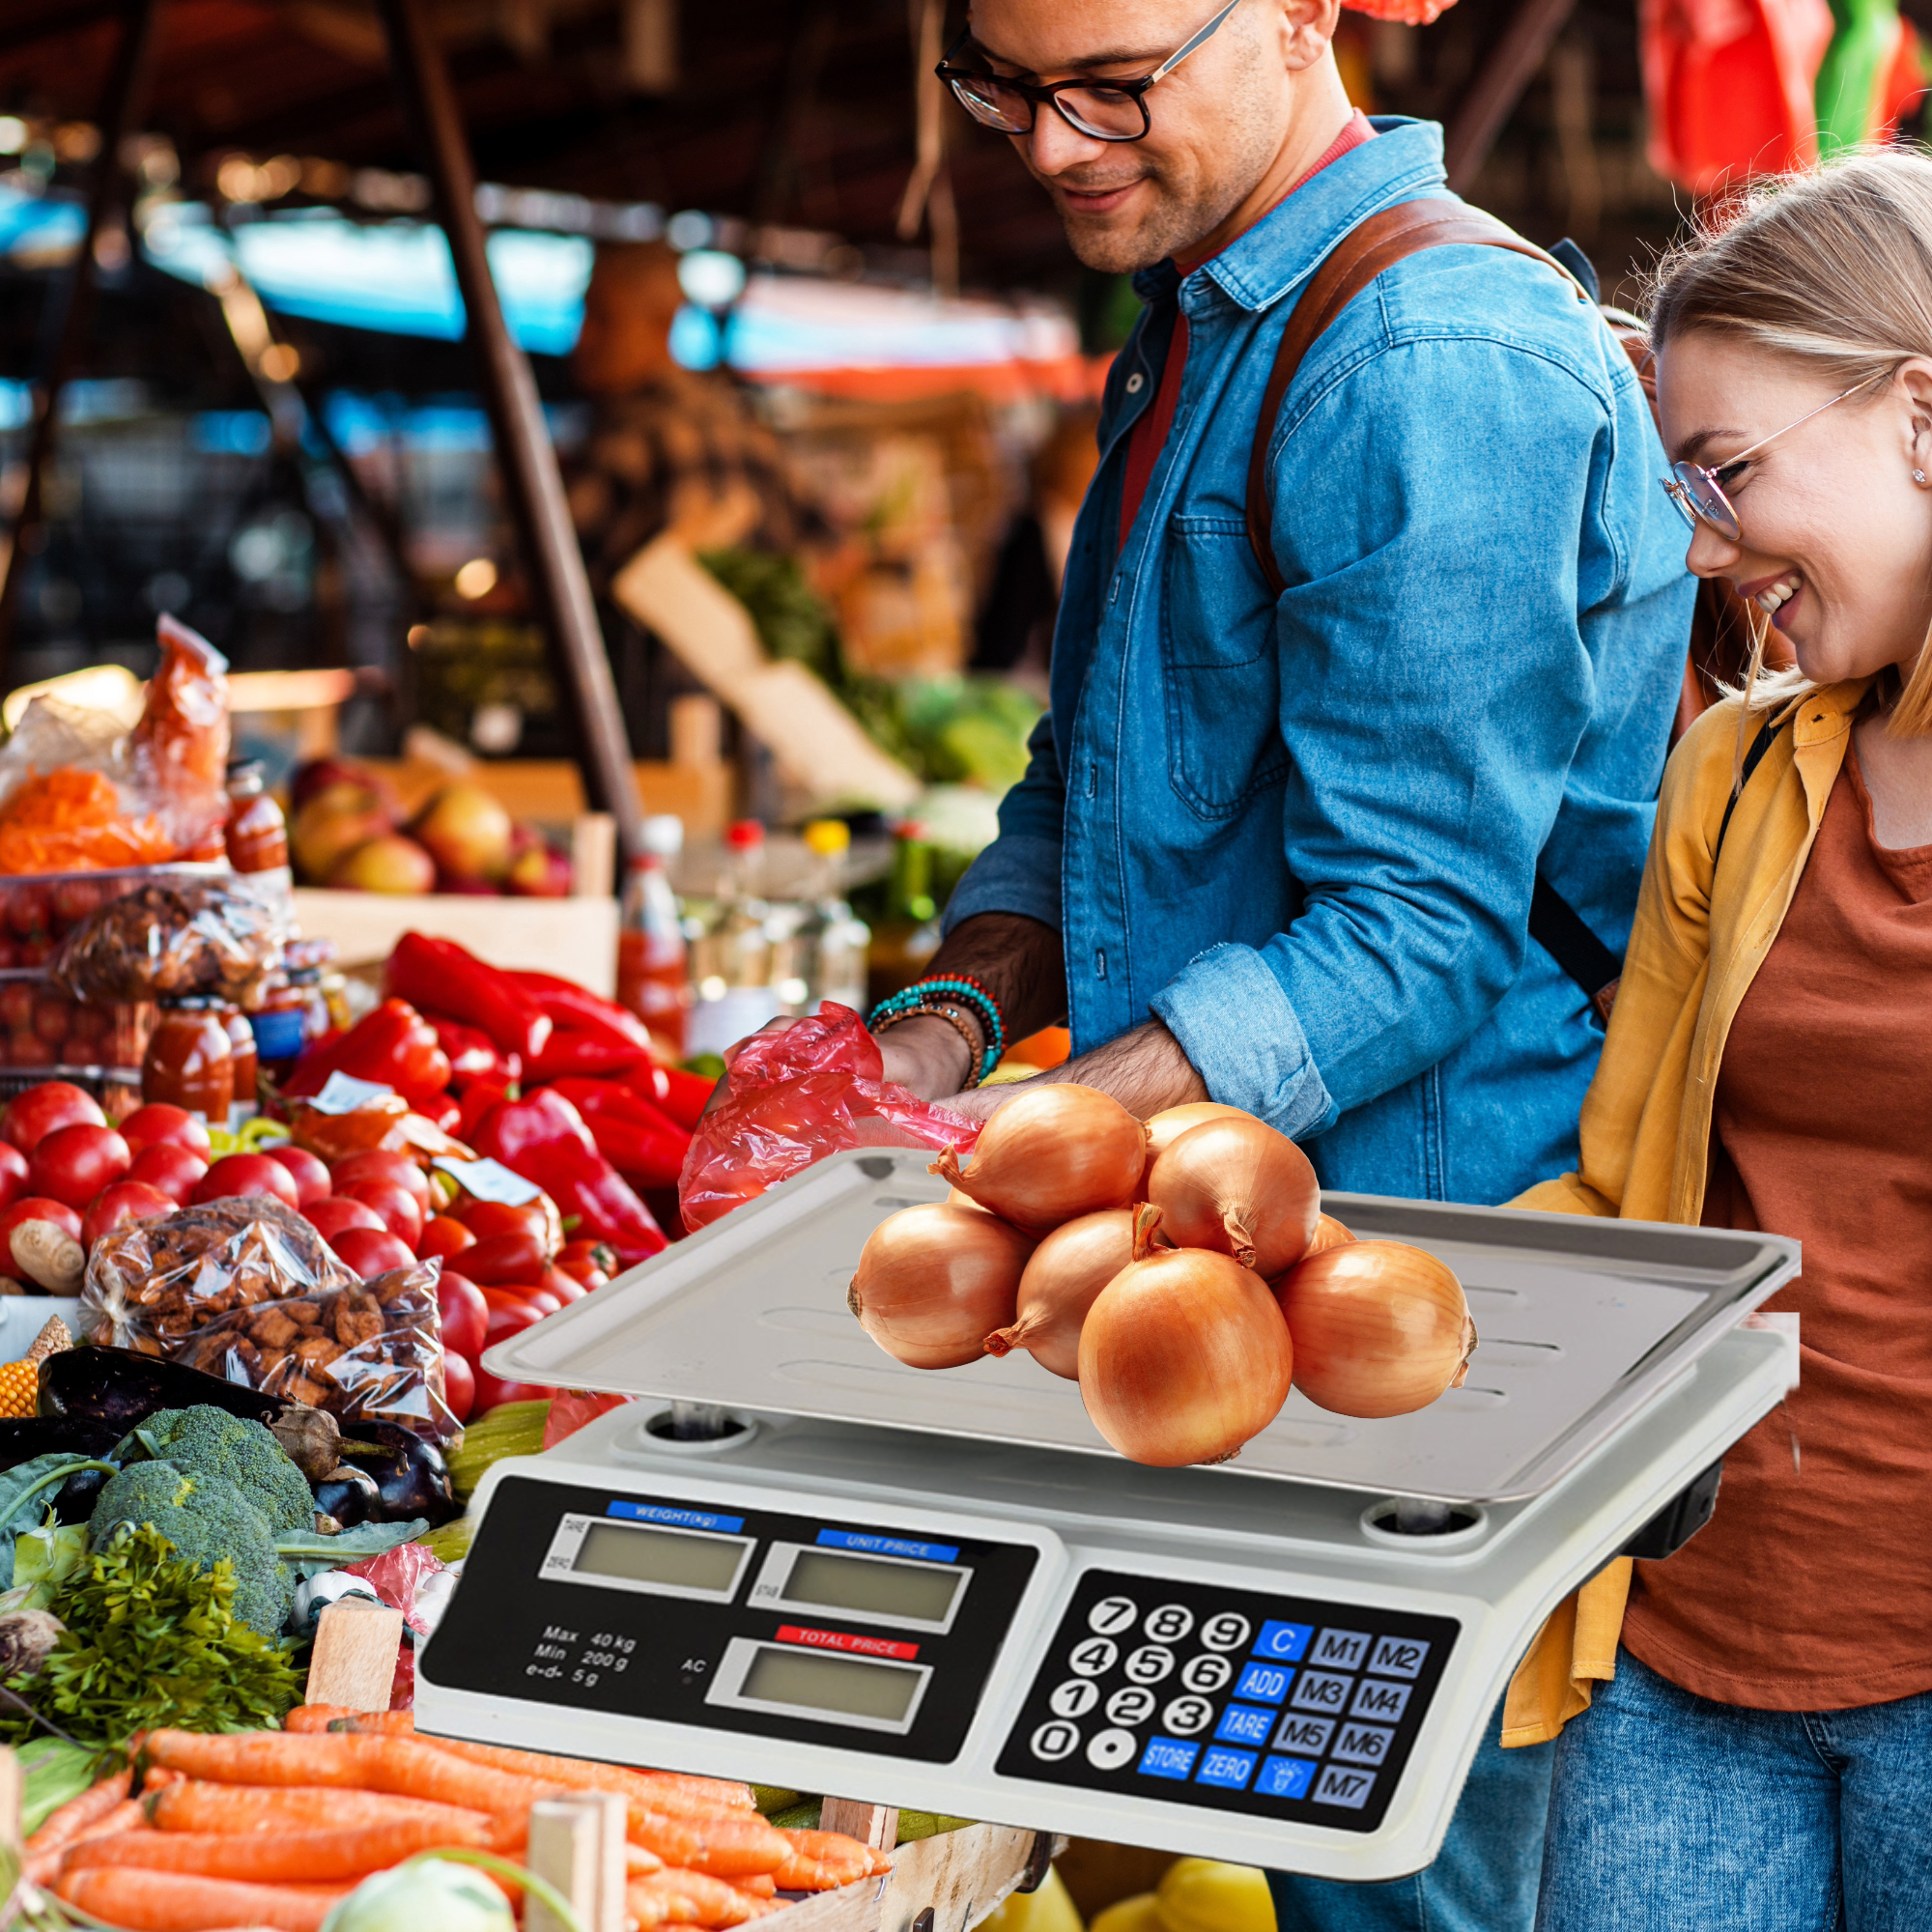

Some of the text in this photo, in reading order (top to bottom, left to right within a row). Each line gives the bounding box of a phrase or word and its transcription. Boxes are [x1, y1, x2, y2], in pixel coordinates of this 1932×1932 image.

[635, 1505, 718, 1527] WEIGHT(kg)
[846, 1535, 930, 1556] UNIT PRICE
[1099, 1601, 1131, 1629] 7
[1151, 1609, 1187, 1637] 8
[543, 1625, 579, 1643] Max
[799, 1630, 899, 1655] TOTAL PRICE
[1209, 1617, 1244, 1646] 9
[1270, 1629, 1295, 1653] C
[534, 1643, 567, 1661] Min
[582, 1650, 615, 1667] 200
[1076, 1643, 1110, 1671] 4
[1321, 1634, 1359, 1662] M1
[1377, 1643, 1421, 1670] M2
[571, 1669, 585, 1683] 5
[680, 1659, 707, 1673] AC
[1133, 1650, 1169, 1679] 5
[1191, 1659, 1225, 1688] 6
[1242, 1669, 1285, 1696] ADD
[1300, 1677, 1345, 1704] M3
[1065, 1684, 1088, 1712] 1
[1112, 1691, 1148, 1722] 2
[1358, 1686, 1400, 1714] M4
[1172, 1700, 1207, 1729] 3
[1225, 1710, 1268, 1739] TARE
[1037, 1725, 1072, 1755] 0
[1282, 1719, 1326, 1747] M5
[1341, 1729, 1385, 1757] M6
[1145, 1745, 1194, 1772] STORE
[1203, 1753, 1251, 1781] ZERO
[1321, 1773, 1367, 1800] M7
